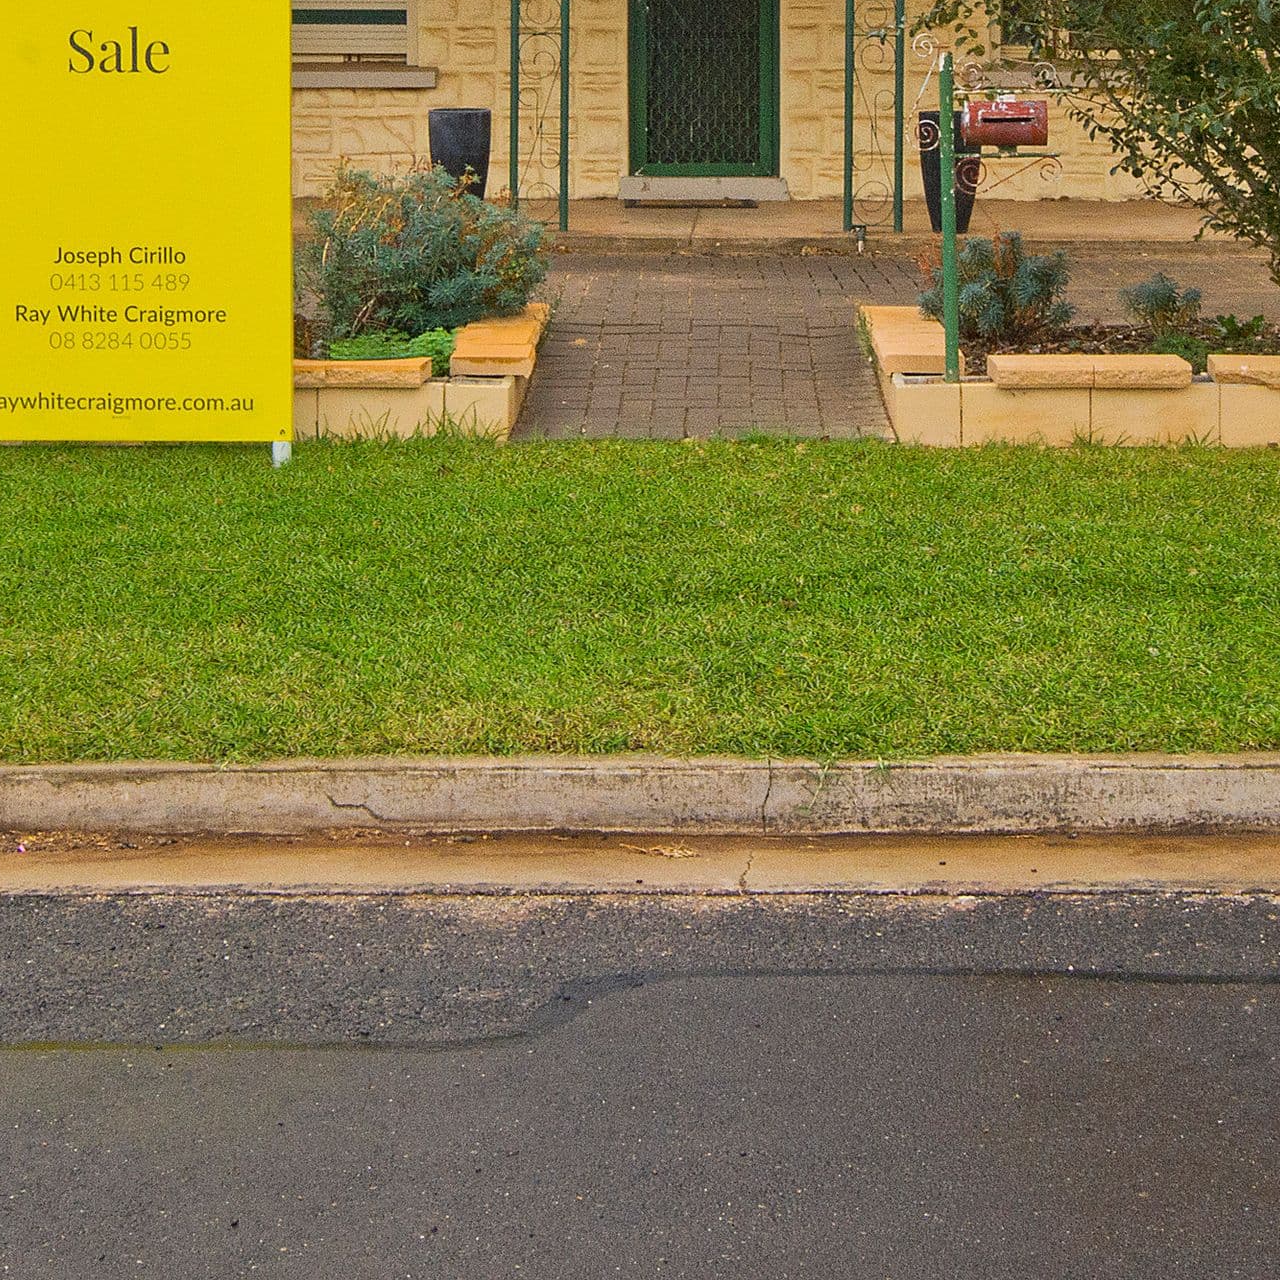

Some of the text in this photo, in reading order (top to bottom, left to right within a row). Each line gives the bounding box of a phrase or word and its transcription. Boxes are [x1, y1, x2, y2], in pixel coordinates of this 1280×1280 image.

[68, 25, 170, 74] Sale
[53, 246, 186, 268] Joseph Cirillo
[49, 272, 191, 292] 0413 115 489
[15, 304, 227, 327] Ray White Craigmore
[48, 331, 192, 350] 08 8284 0055
